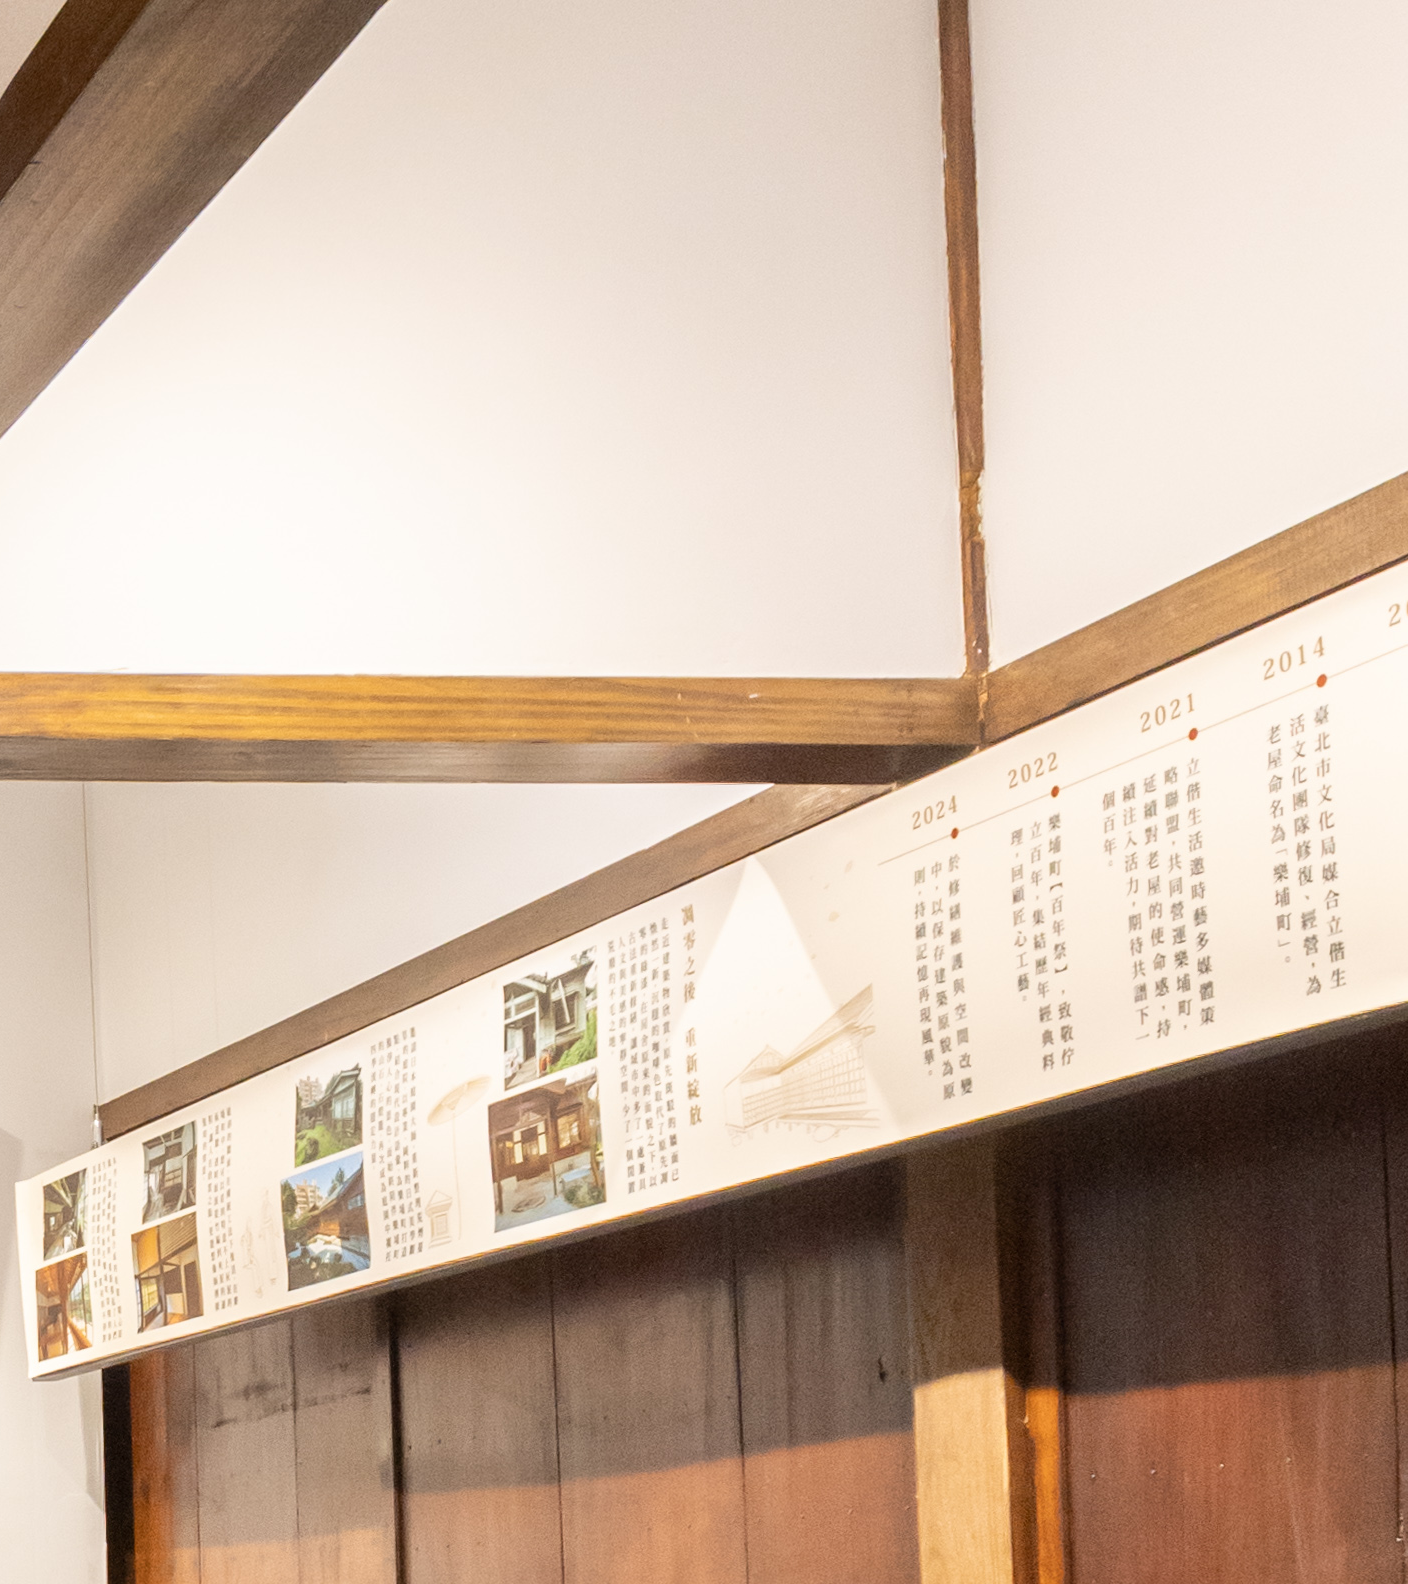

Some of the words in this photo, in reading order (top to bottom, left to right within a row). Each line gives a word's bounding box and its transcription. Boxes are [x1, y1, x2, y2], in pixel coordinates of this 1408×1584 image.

[1262, 636, 1325, 681] 2014
[1139, 693, 1195, 733] 2021
[1007, 752, 1058, 789] 2022
[911, 795, 958, 831] 2024
